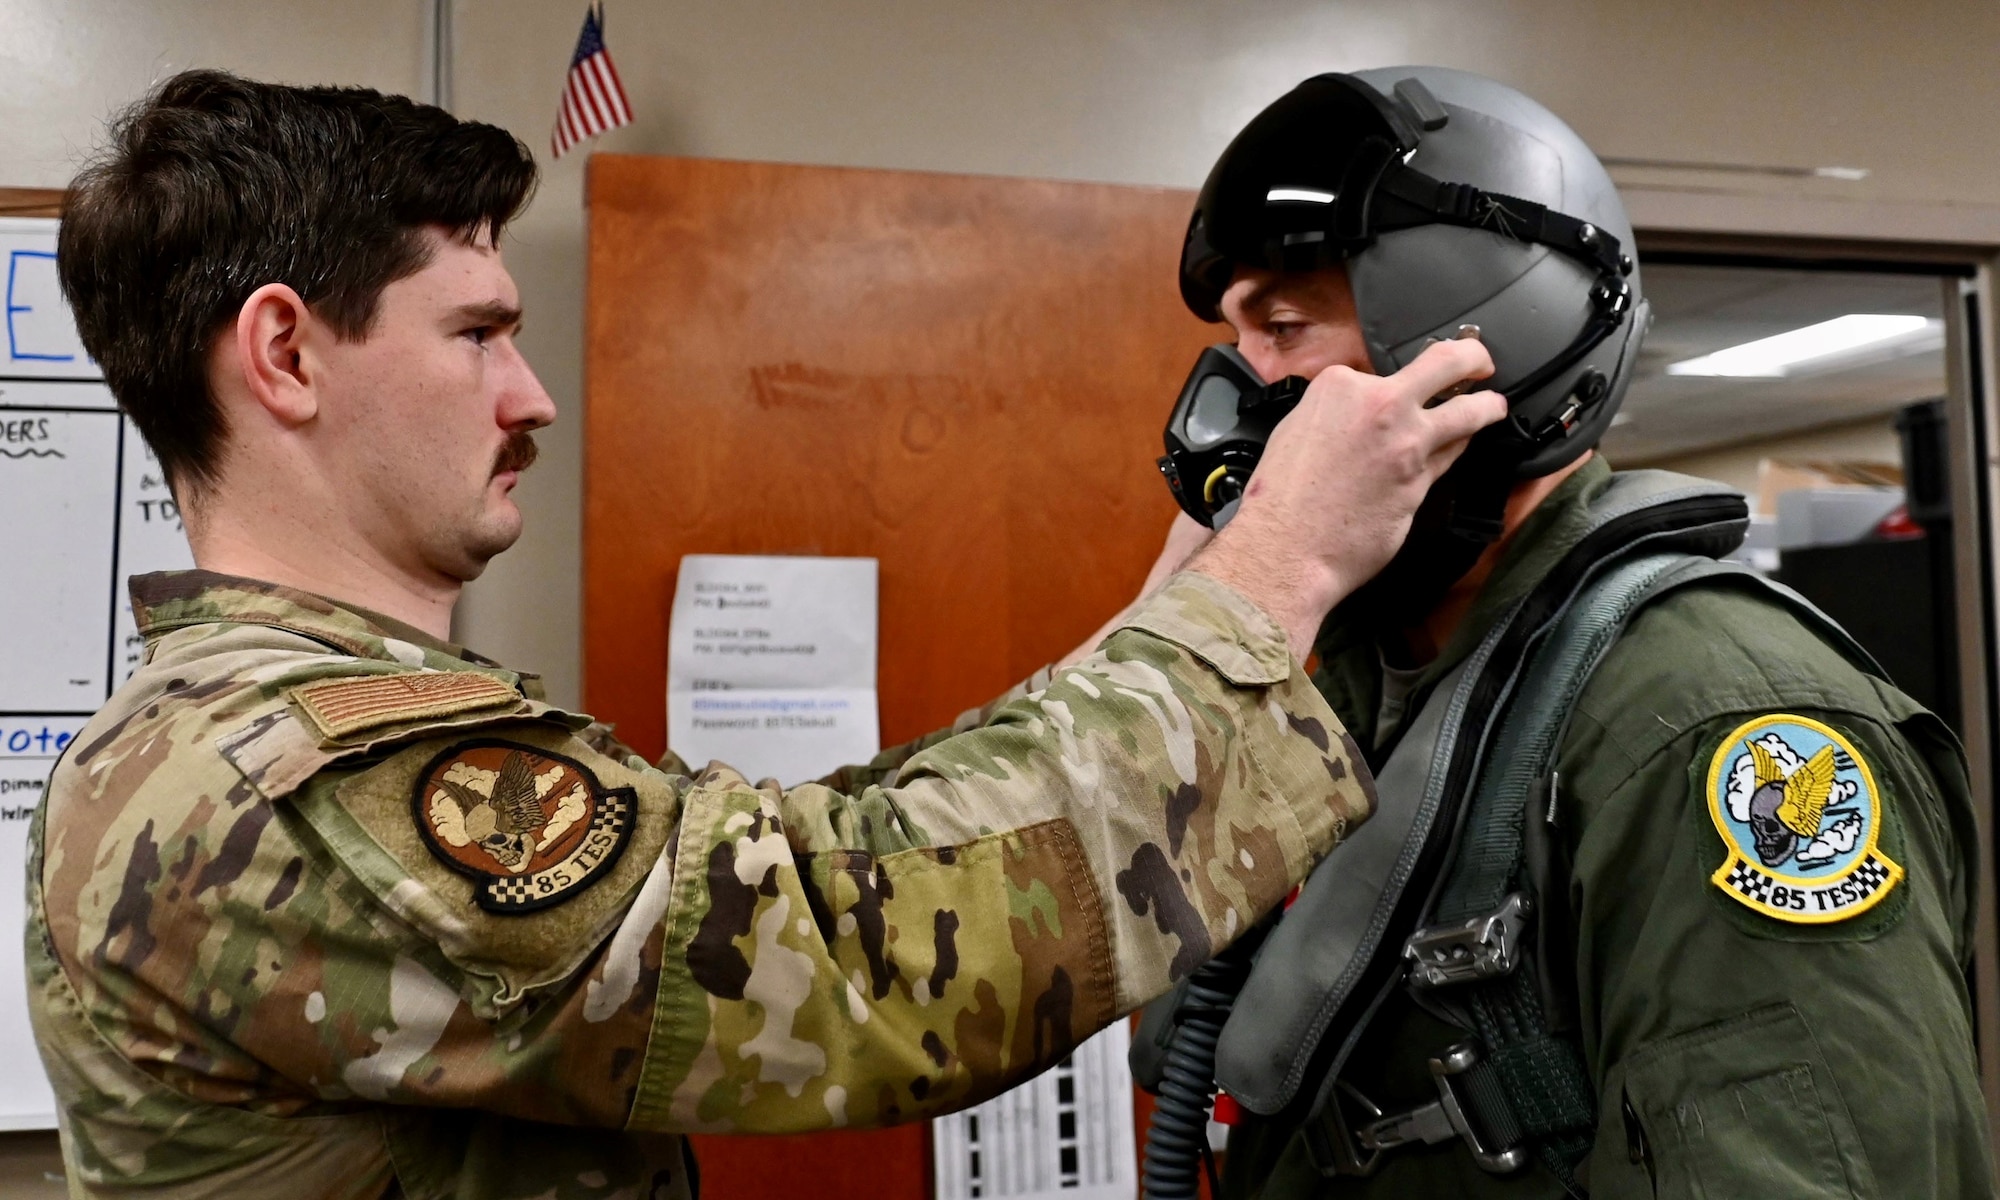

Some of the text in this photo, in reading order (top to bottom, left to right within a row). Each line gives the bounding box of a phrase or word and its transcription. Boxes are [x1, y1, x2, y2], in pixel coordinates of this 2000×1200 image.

[0, 726, 71, 753] ote
[536, 832, 611, 893] 85 TES
[1771, 882, 1857, 910] 85 TES
